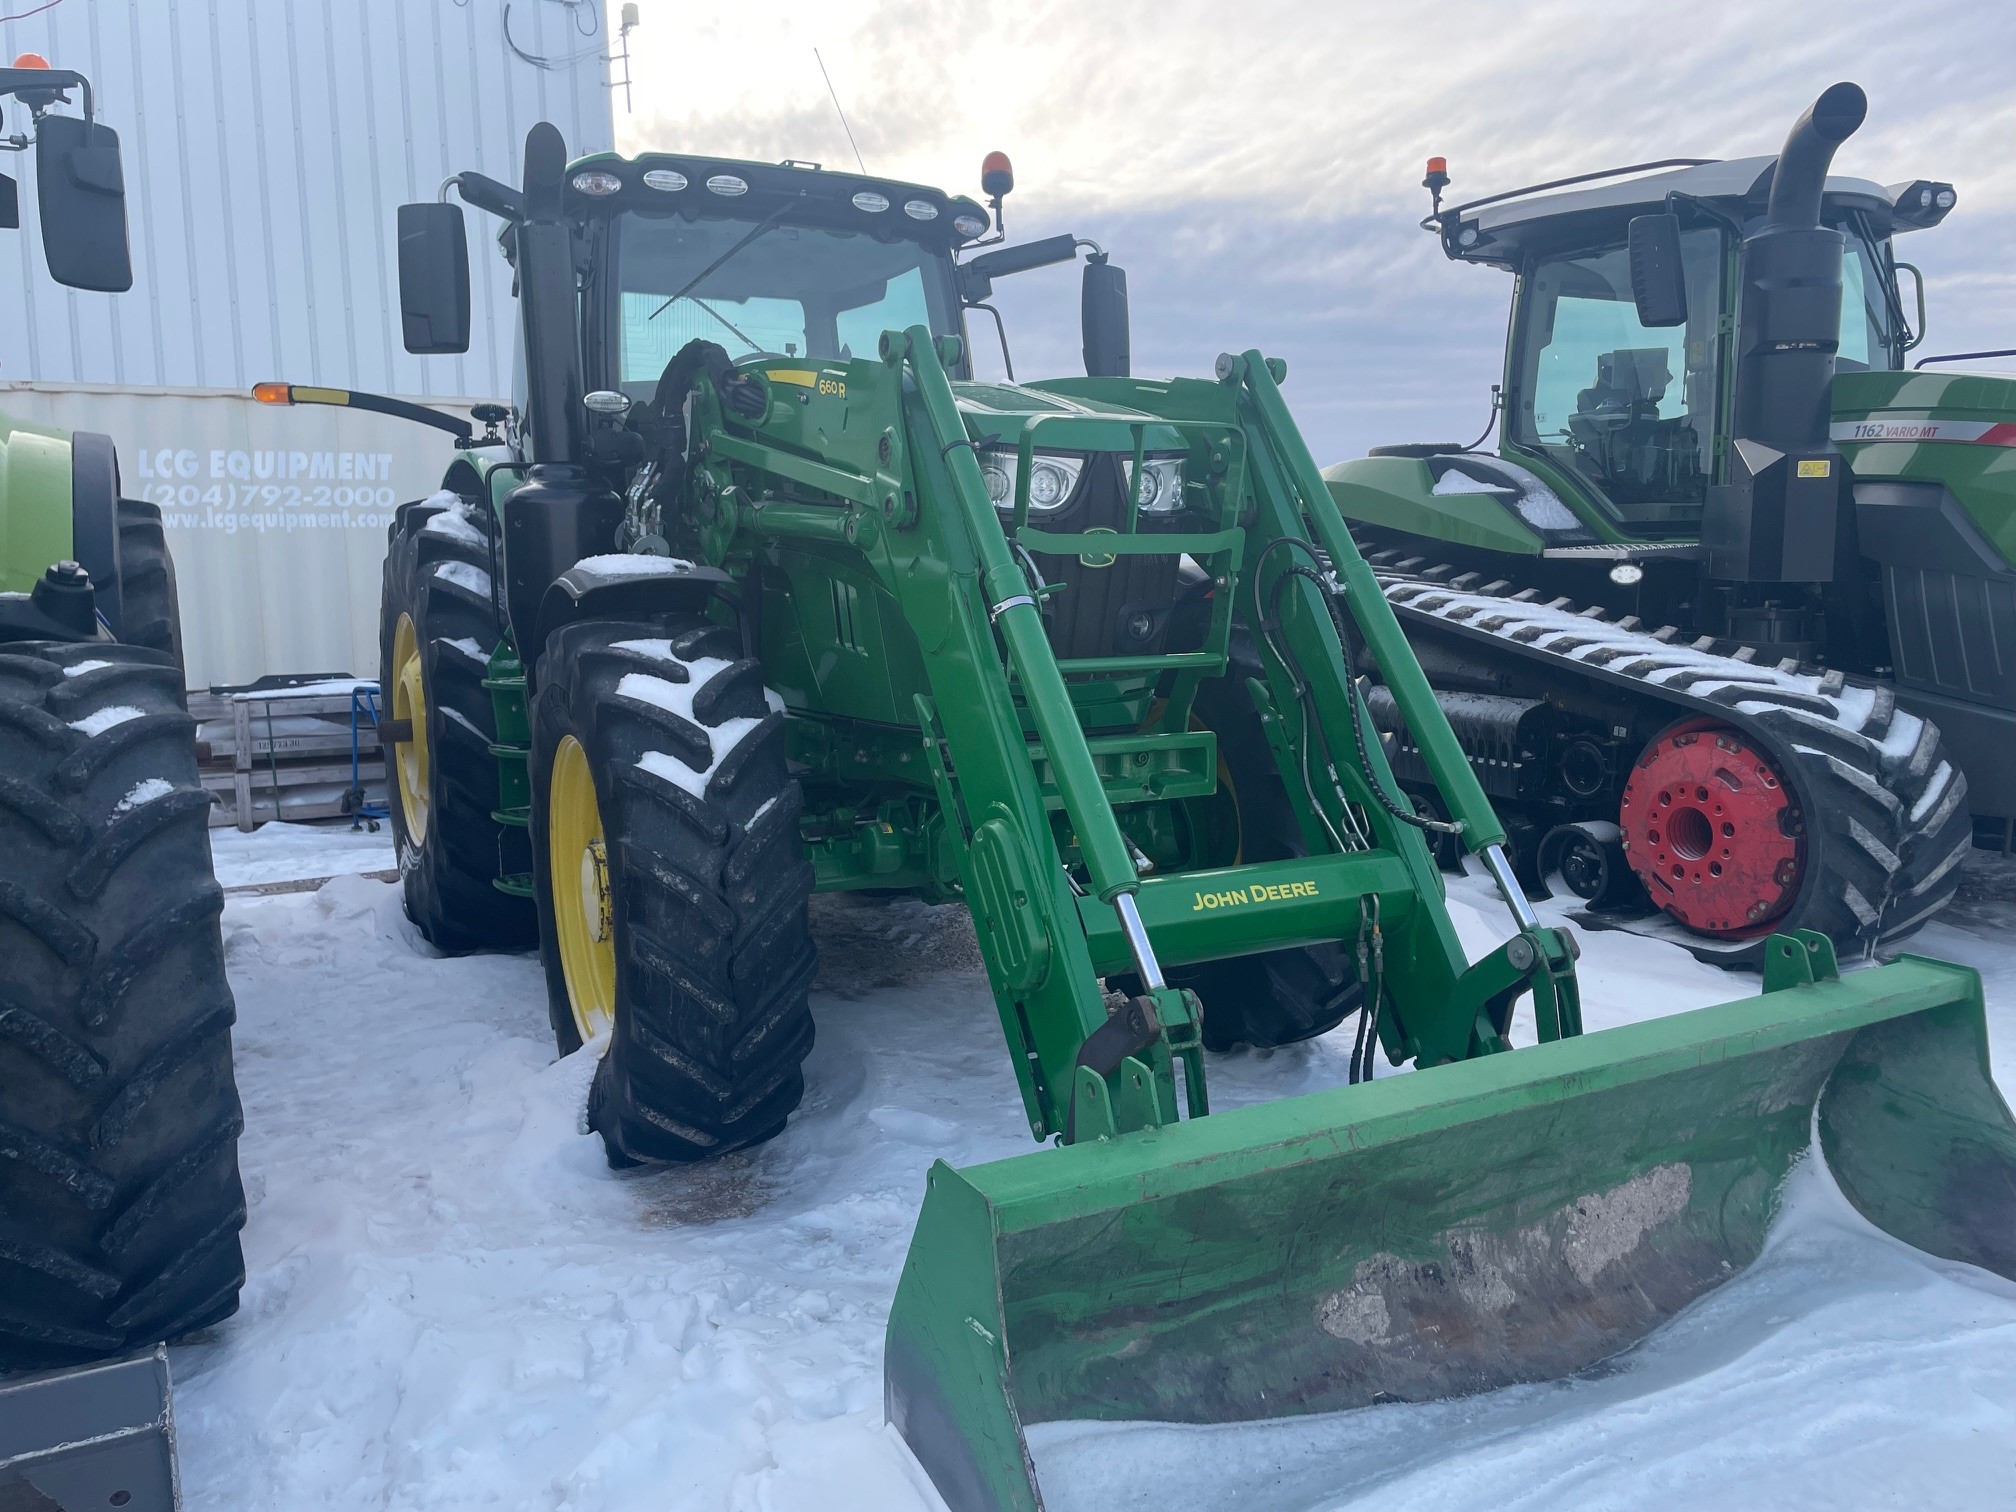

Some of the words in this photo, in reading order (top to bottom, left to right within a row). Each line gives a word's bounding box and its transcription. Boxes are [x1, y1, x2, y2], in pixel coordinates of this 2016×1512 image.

[1854, 424, 1883, 438] 1162
[1885, 426, 1919, 437] VARIO
[1919, 426, 1939, 438] MT
[138, 449, 199, 479] LCG
[209, 450, 393, 481] EQUIPMENT
[142, 484, 395, 510] (204)792-2000
[163, 506, 393, 534] ww.lcgequipment.com
[1192, 889, 1249, 911] JOHN
[1249, 880, 1319, 903] DEERE
